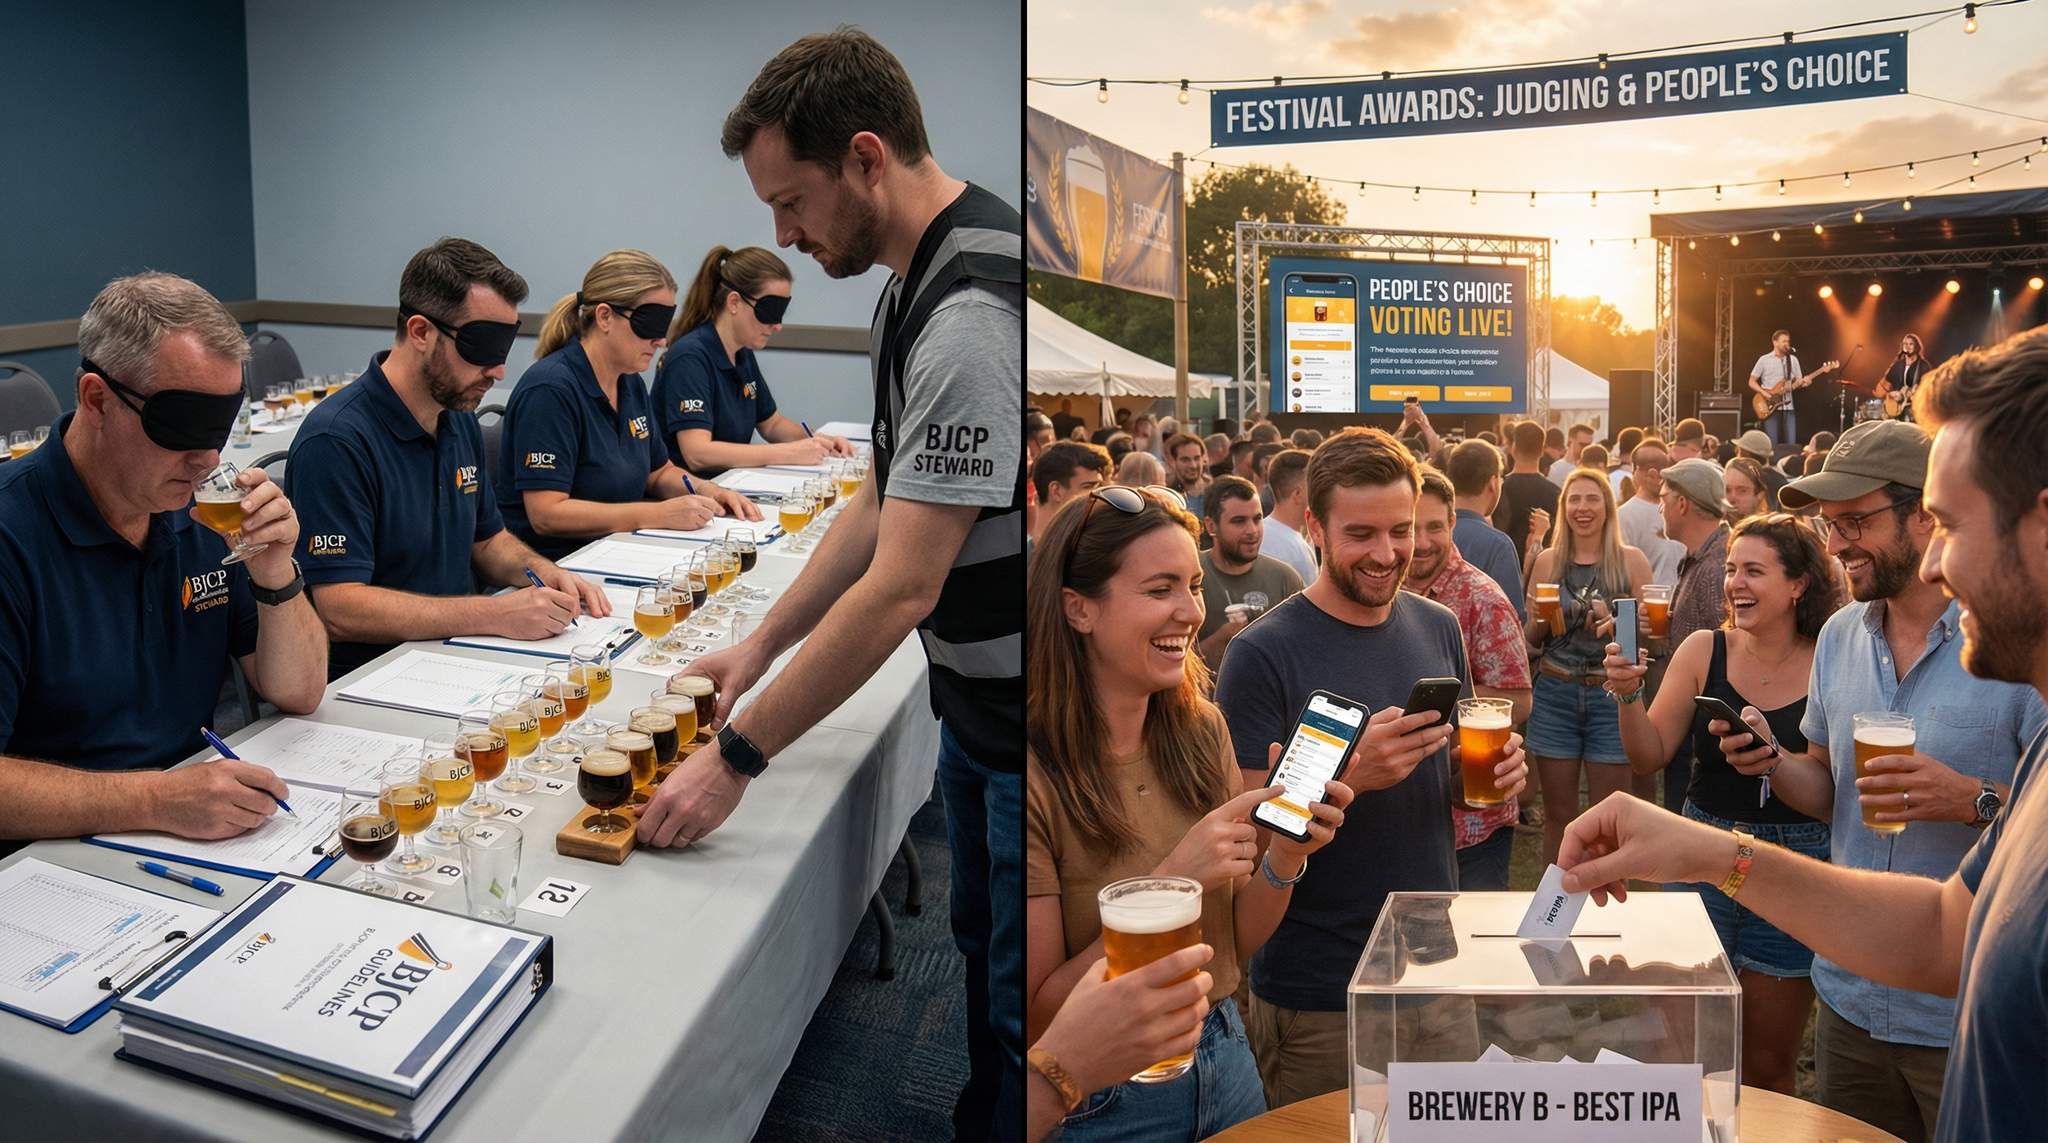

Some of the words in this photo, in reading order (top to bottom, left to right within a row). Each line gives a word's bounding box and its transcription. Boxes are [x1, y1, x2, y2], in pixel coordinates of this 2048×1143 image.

[1226, 95, 1352, 133] FESTIVAL
[1359, 86, 1484, 126] AWARDS:
[1492, 75, 1609, 117] JUDGING
[1618, 74, 1637, 106] &
[1646, 59, 1779, 104] PEOPLE'S
[1786, 48, 1890, 90] CHOICE
[1369, 278, 1449, 302] PEOPLE'S
[1453, 281, 1513, 304] CHOICE
[1369, 305, 1451, 336] VOTING
[1458, 307, 1513, 337] LIVE!
[925, 423, 989, 454] BJCP
[531, 453, 556, 465] BJCP
[914, 454, 994, 477] STEWARD
[314, 534, 346, 550] BJCP
[191, 569, 227, 596] BJCP
[237, 941, 267, 964] BJCP
[318, 948, 393, 1018] GUIDELINES
[348, 960, 434, 1031] BJCP
[1408, 1091, 1526, 1121] BREWERY
[1533, 1091, 1549, 1121] B
[1573, 1091, 1635, 1121] BEST
[1641, 1091, 1681, 1121] IPA
